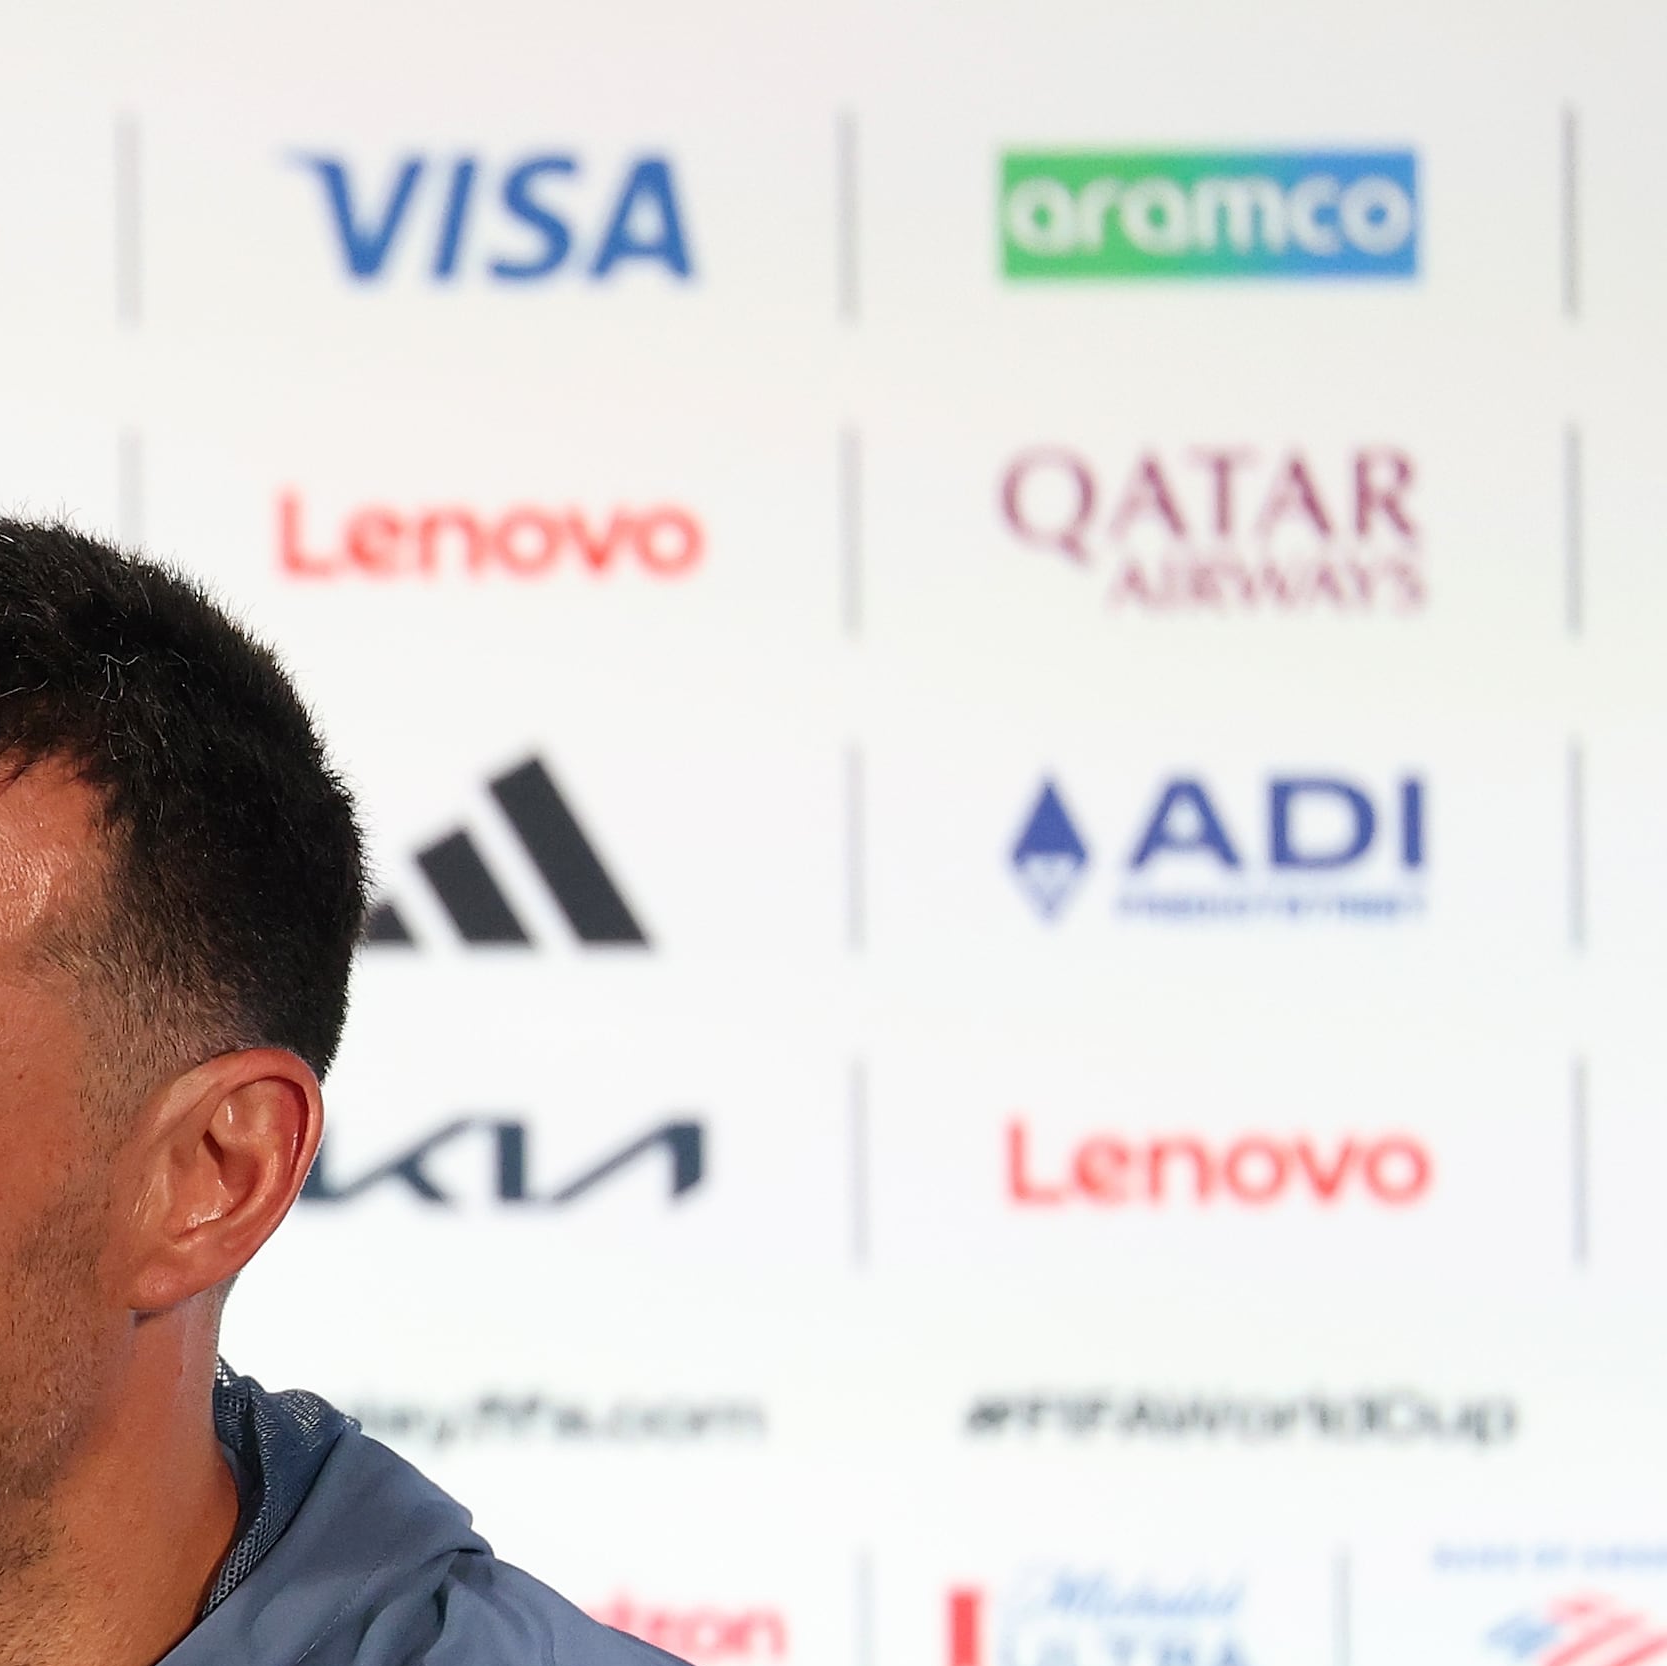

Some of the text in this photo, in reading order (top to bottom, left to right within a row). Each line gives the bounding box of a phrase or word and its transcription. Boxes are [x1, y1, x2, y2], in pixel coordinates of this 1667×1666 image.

[299, 150, 697, 287] VISA
[1005, 175, 1414, 258] aramco
[275, 489, 708, 582] Lenovo
[997, 446, 1419, 563] QATAR
[1112, 557, 1428, 613] AIRWAYS
[1126, 774, 1427, 872] ADI
[1003, 1117, 1436, 1209] Lenovo
[962, 1389, 1521, 1451] #FIFAWorldCup
